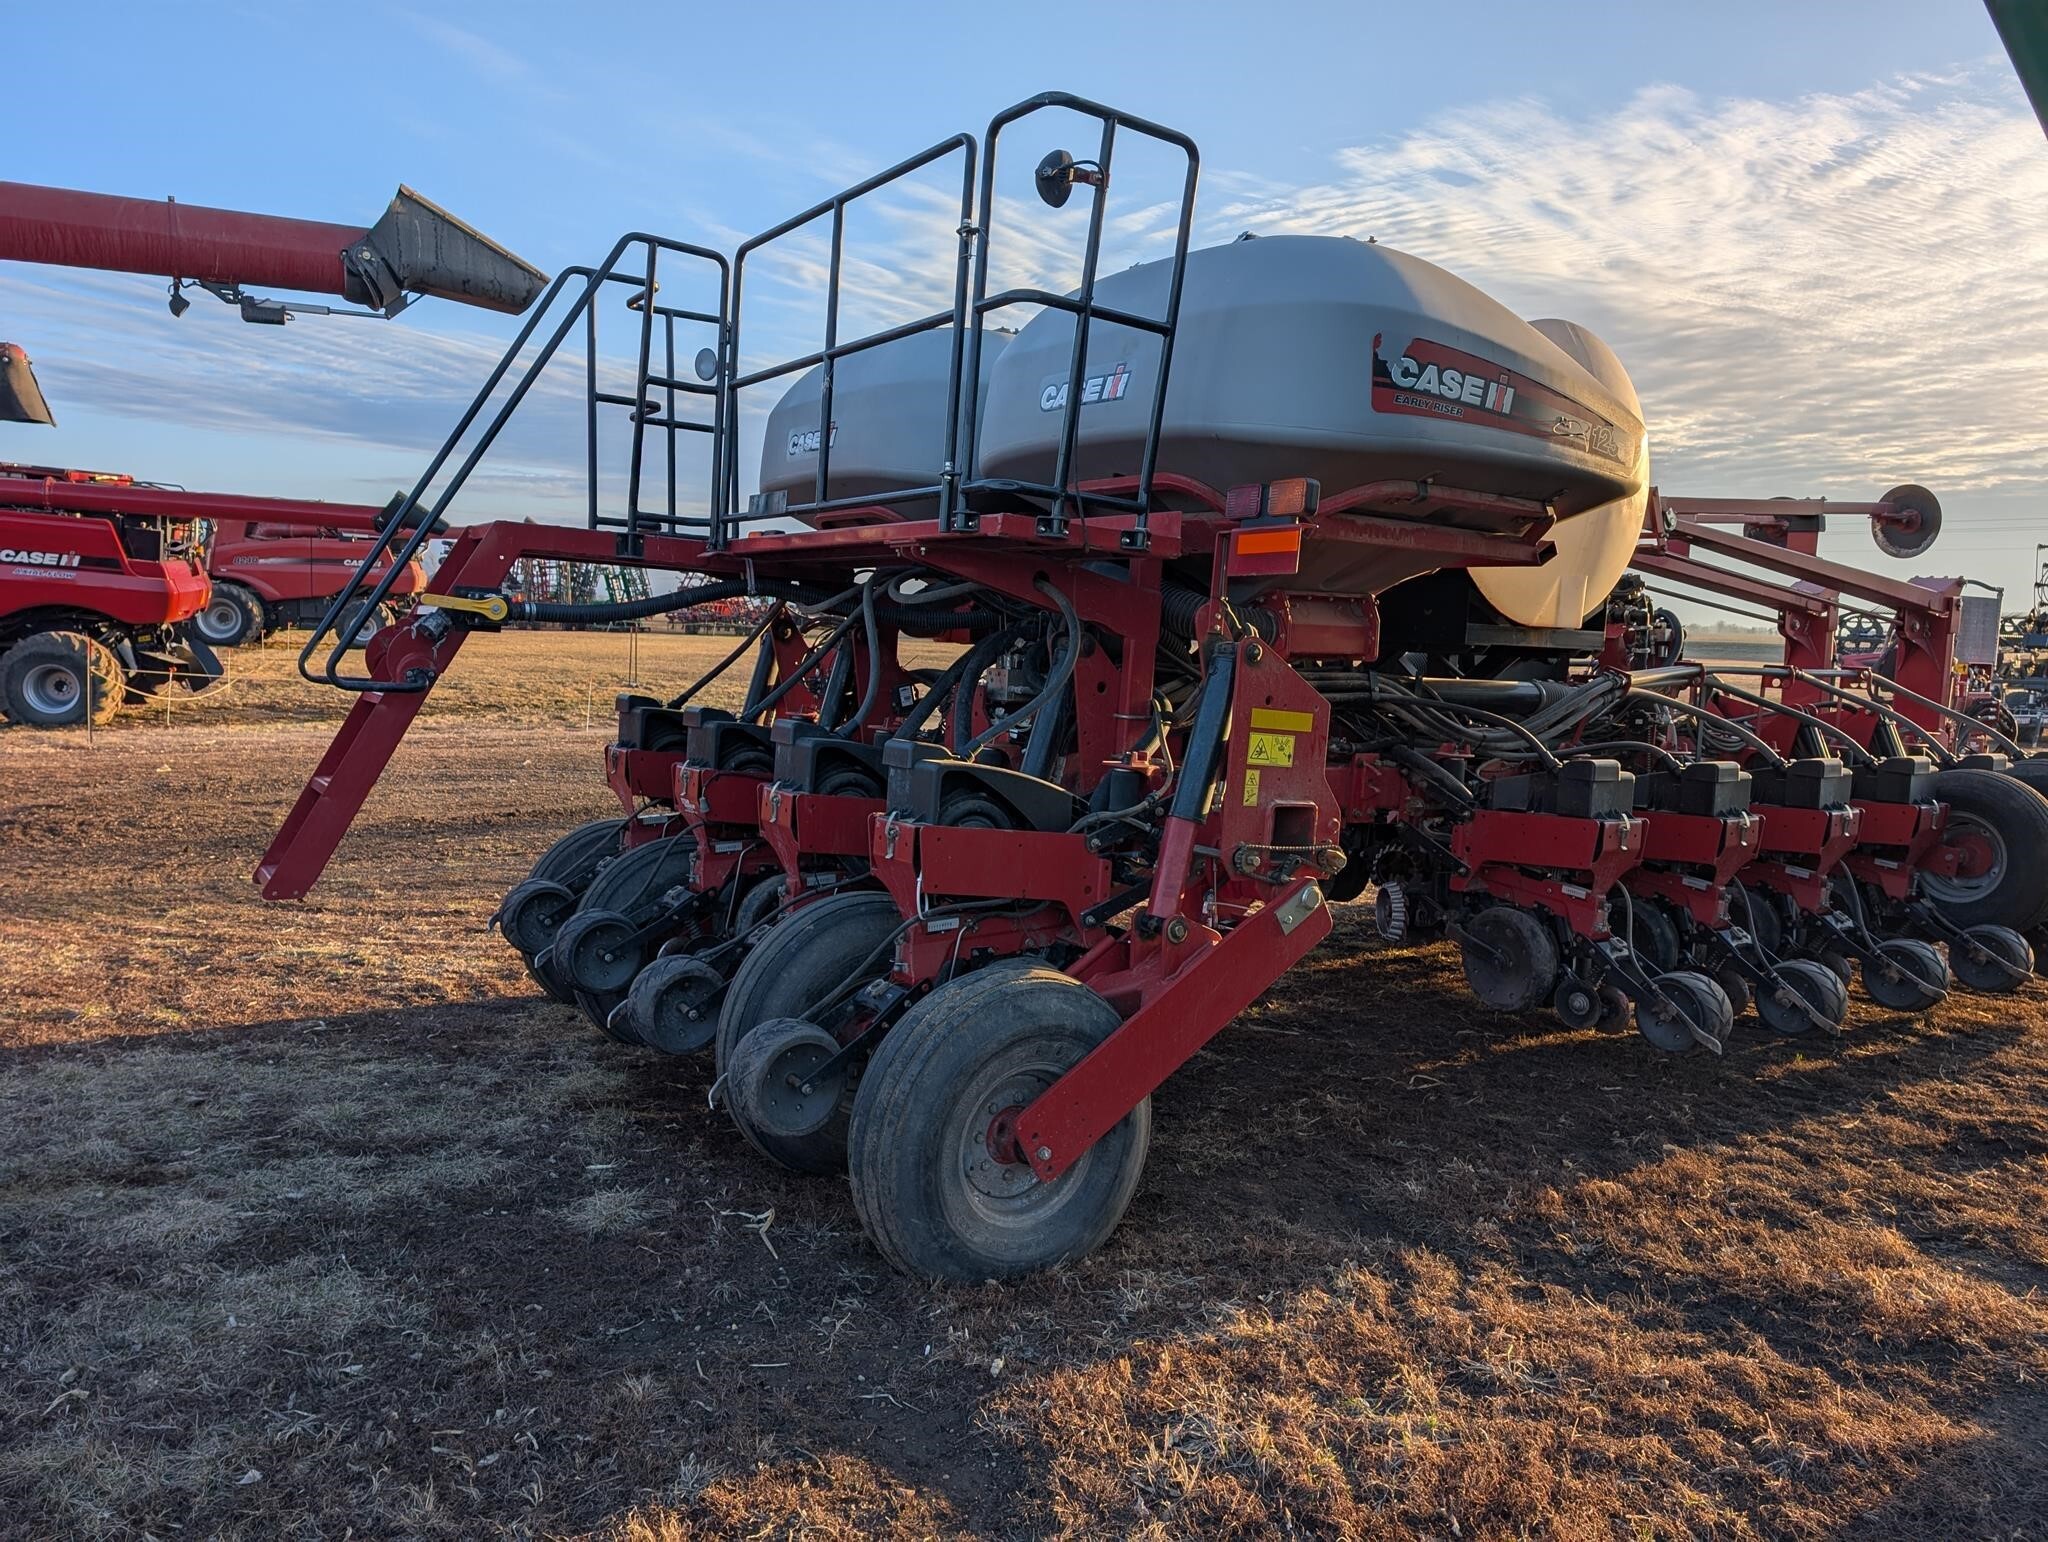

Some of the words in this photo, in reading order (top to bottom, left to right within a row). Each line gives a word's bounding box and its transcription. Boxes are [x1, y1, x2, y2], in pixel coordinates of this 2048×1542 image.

[1040, 375, 1104, 411] CAE
[1394, 394, 1431, 409] EARLY
[1432, 402, 1464, 417] RISER
